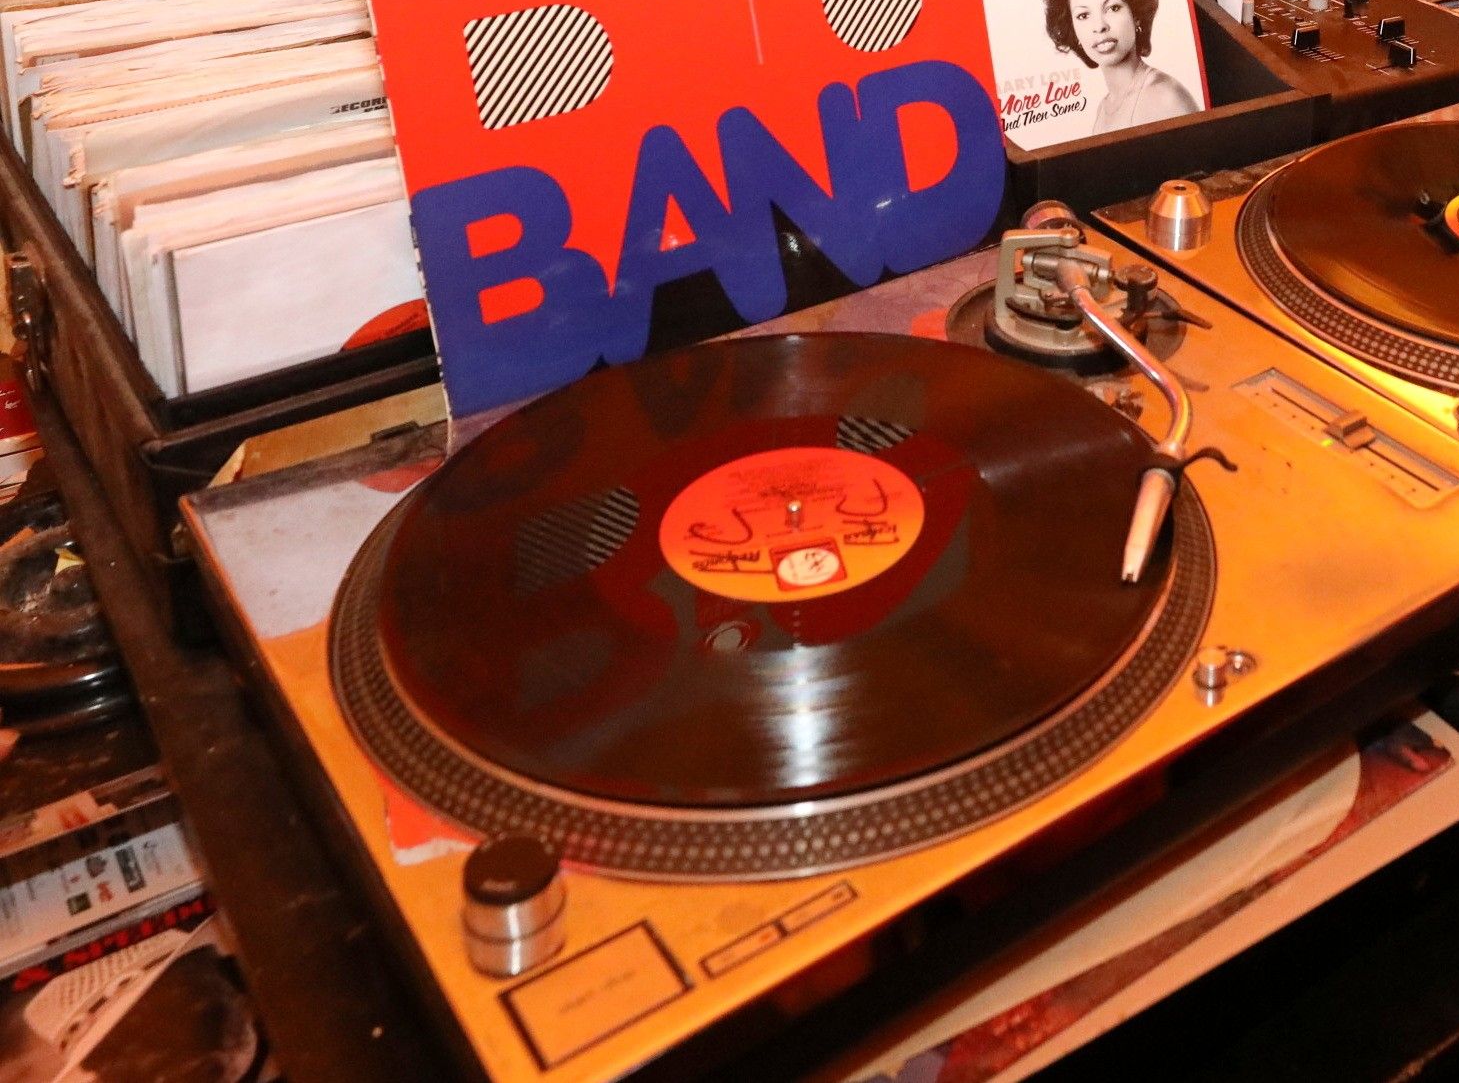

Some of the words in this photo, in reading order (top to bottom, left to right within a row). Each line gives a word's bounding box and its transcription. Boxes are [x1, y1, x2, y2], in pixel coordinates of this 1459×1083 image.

[1000, 75, 1036, 94] ARY
[1039, 68, 1081, 86] LOVE
[1044, 81, 1082, 105] Love
[1022, 110, 1049, 127] Then
[410, 59, 1007, 420] BAND
